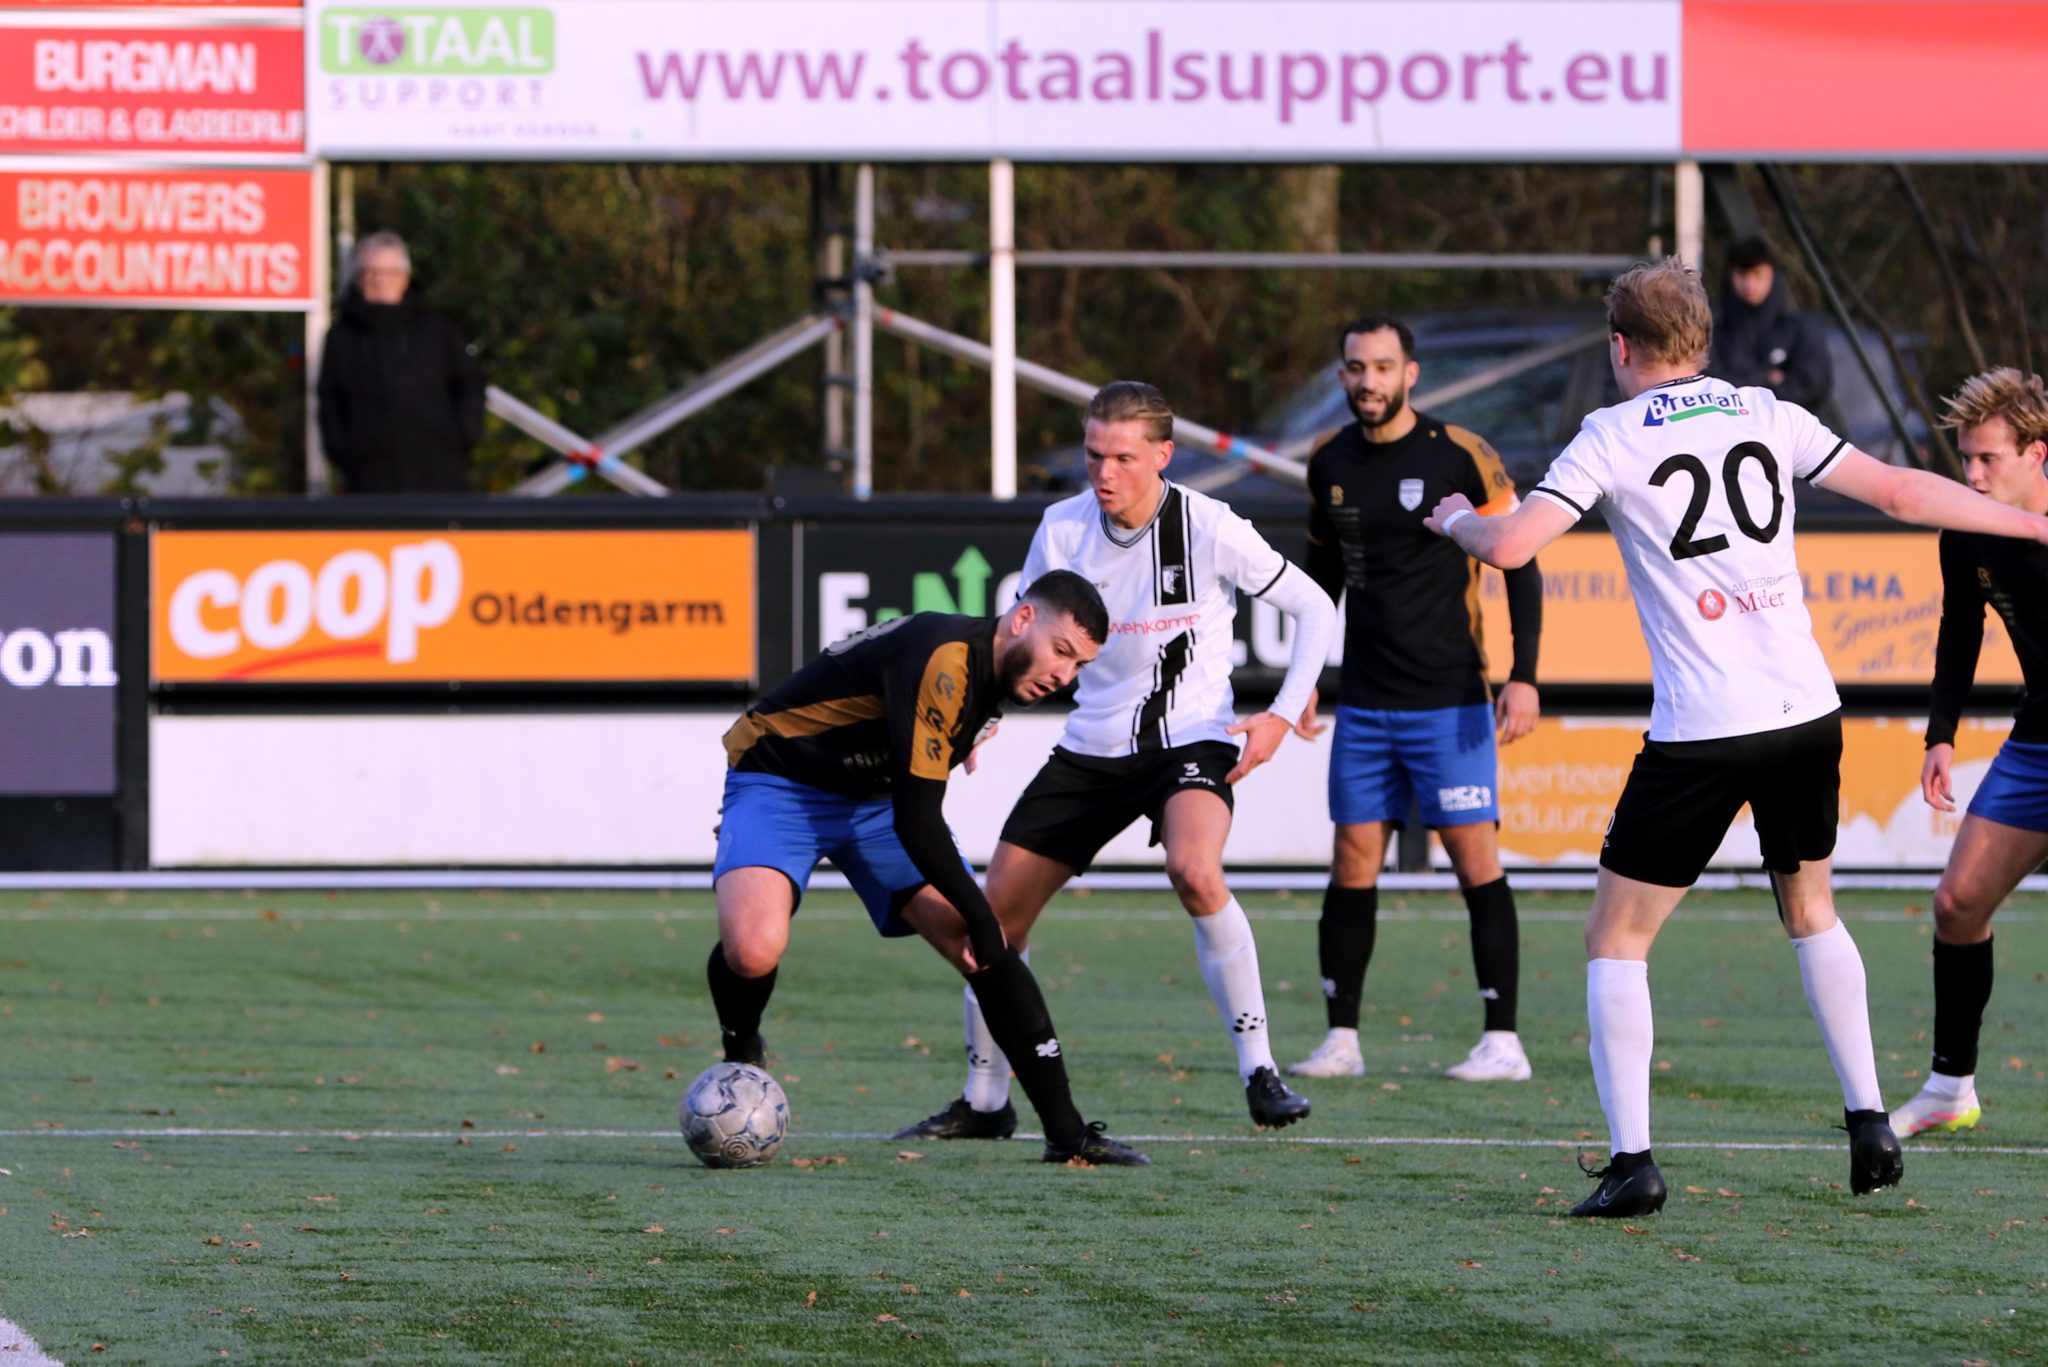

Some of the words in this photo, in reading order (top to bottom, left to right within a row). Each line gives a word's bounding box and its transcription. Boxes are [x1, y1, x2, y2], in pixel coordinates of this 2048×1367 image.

[34, 39, 257, 93] BURGMAN
[636, 27, 1669, 125] www.totaalsupport.eu
[327, 78, 545, 110] SUPPORT
[107, 107, 131, 139] &
[17, 179, 266, 234] BROUWERS
[1646, 392, 1744, 422] Breman
[1648, 441, 1784, 560] 20
[168, 539, 463, 664] coop
[471, 592, 726, 636] Oldengarm
[1183, 762, 1200, 777] 3
